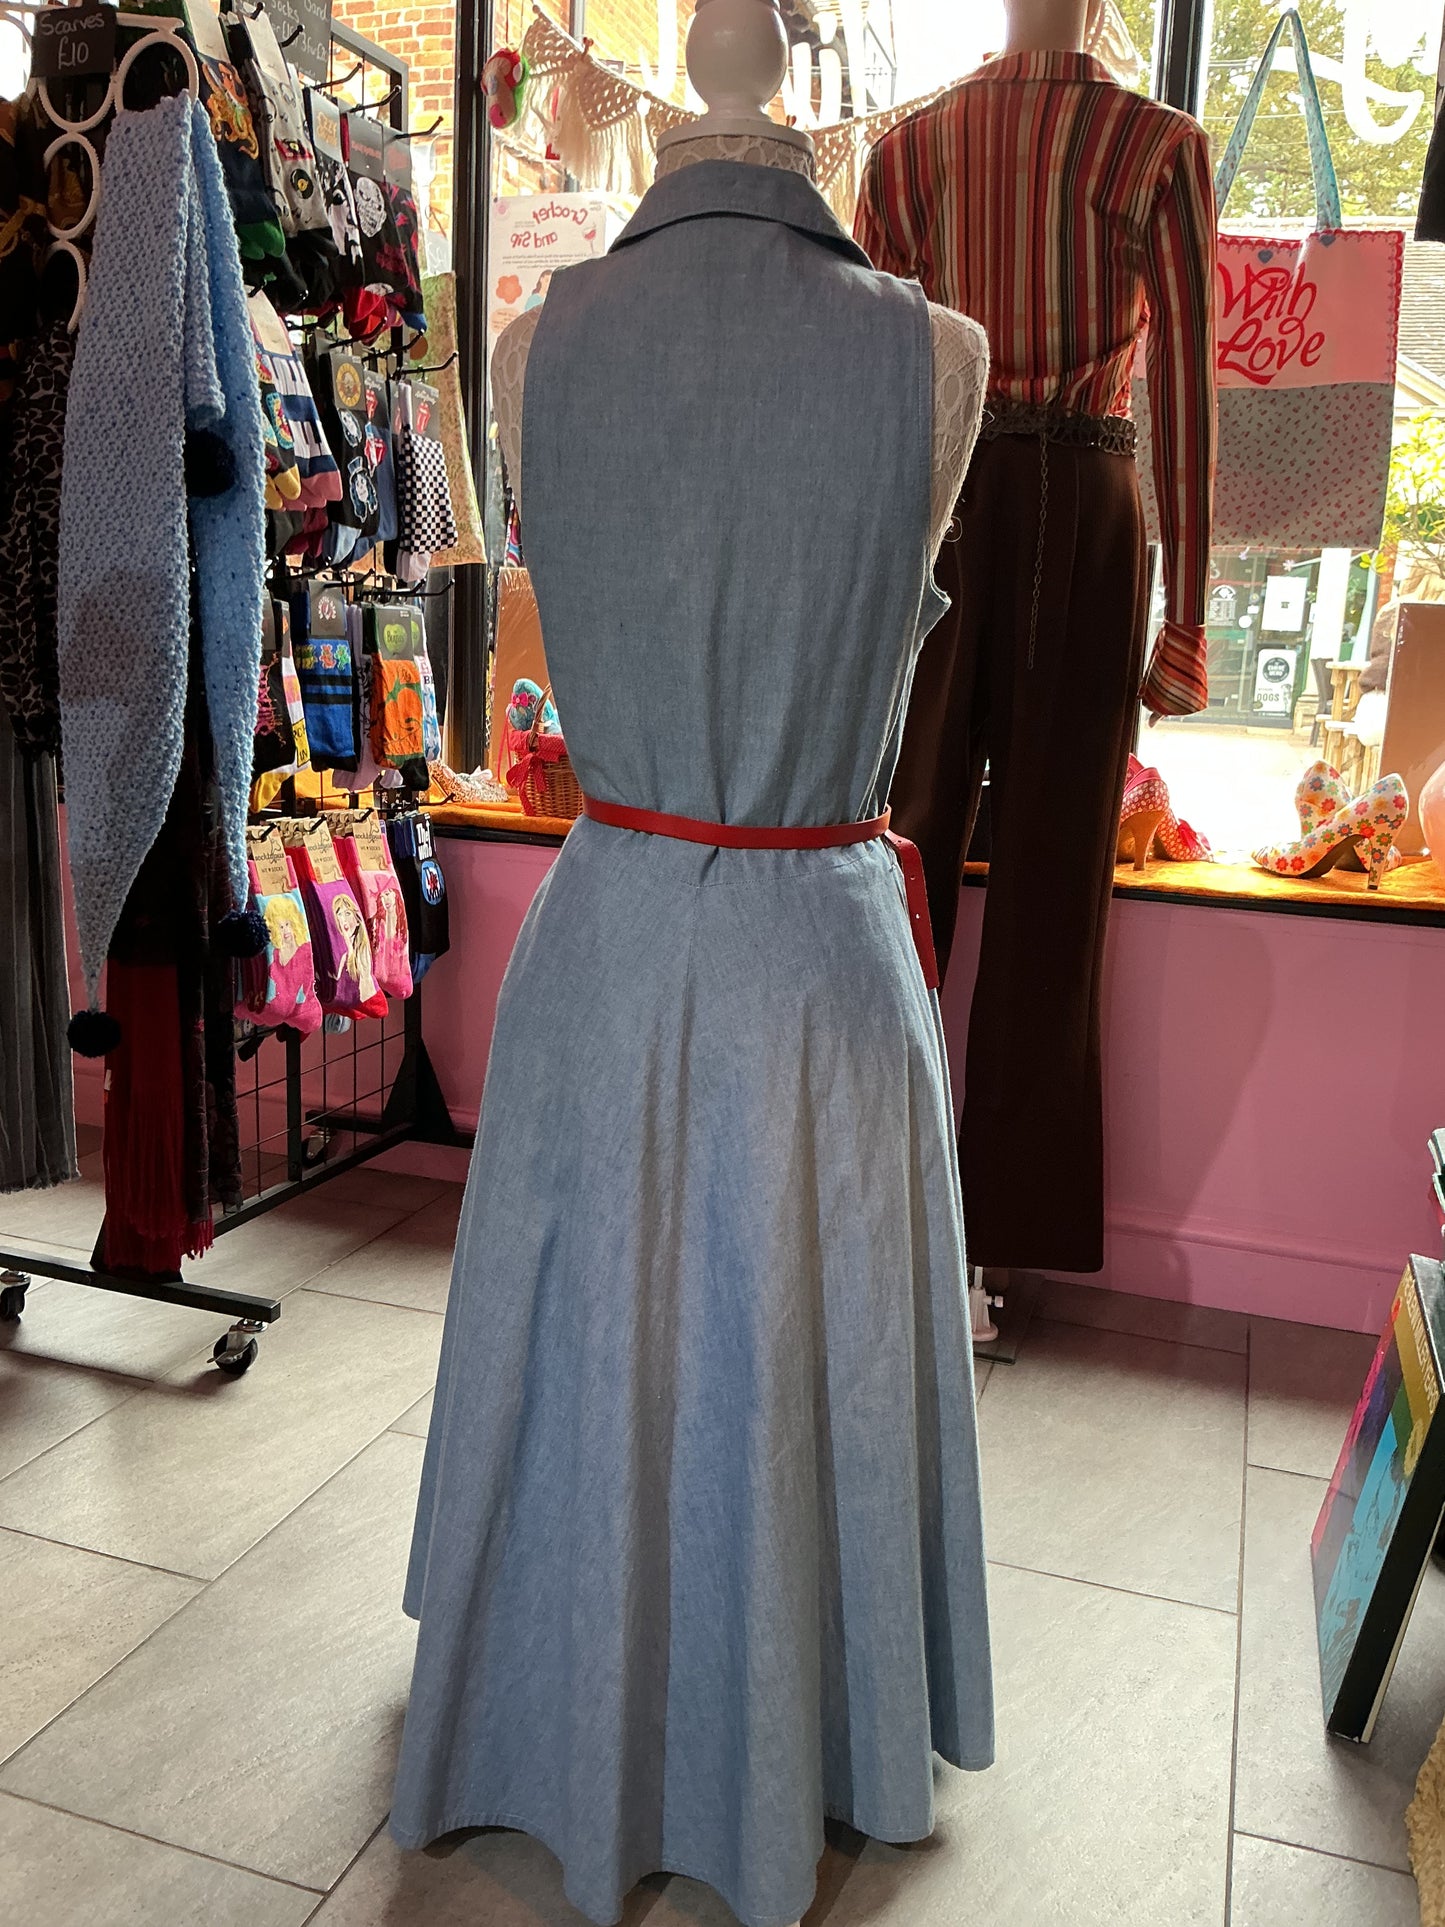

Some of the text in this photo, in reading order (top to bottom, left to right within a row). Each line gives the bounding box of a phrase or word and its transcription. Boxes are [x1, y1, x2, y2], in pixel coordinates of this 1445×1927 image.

[40, 12, 105, 36] Scarves
[58, 35, 89, 70] £10
[1217, 262, 1317, 321] With
[1217, 317, 1325, 385] Love
[1257, 692, 1280, 702] DOGS
